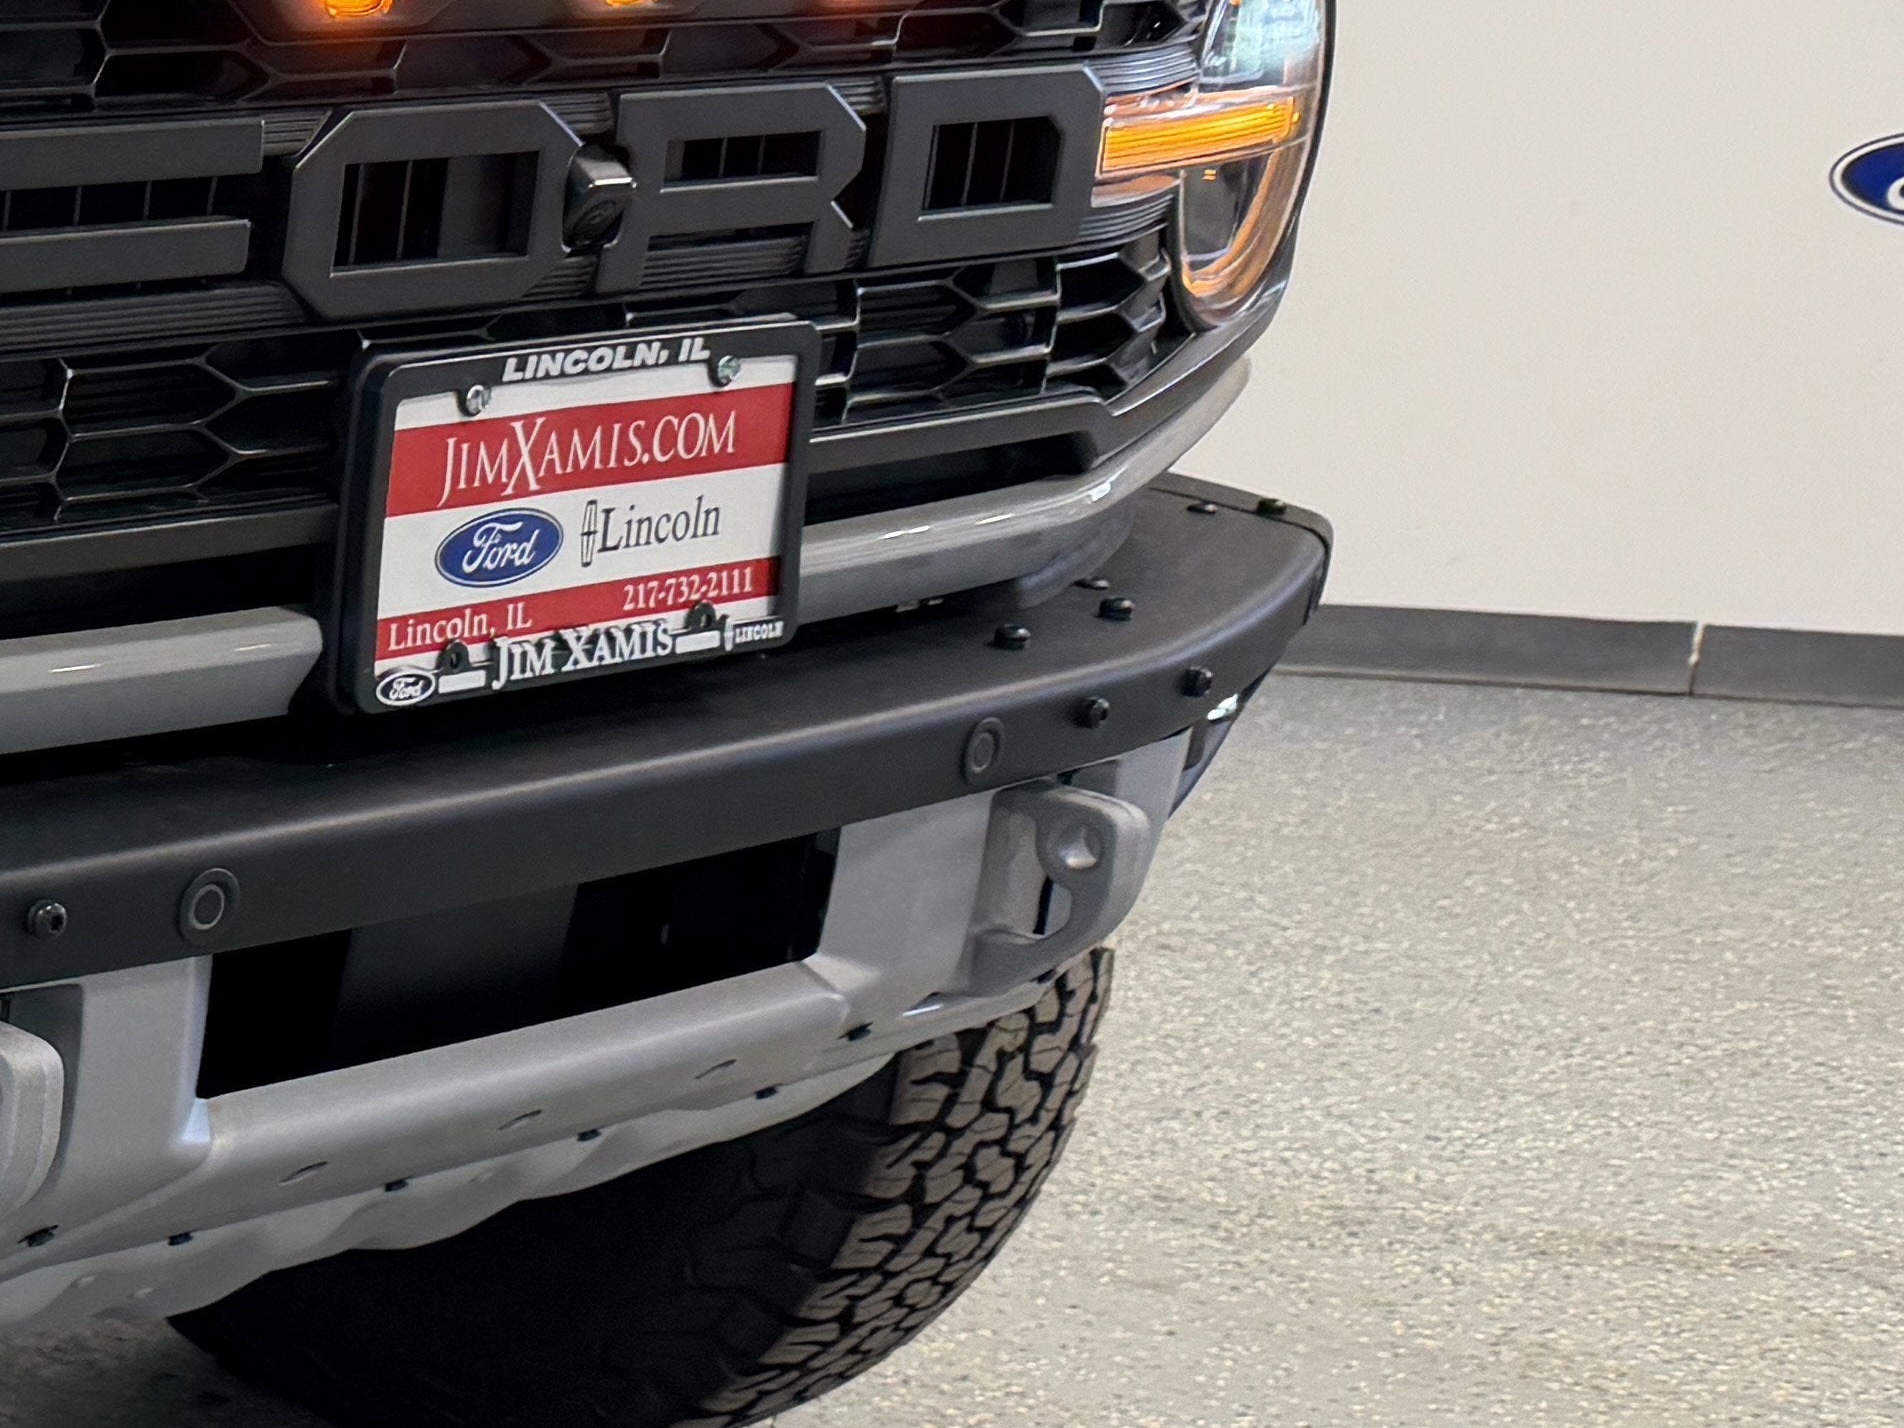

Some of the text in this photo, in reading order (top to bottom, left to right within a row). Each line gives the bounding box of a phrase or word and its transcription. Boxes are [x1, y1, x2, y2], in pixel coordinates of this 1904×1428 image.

[502, 337, 710, 382] LINCOLN, IL
[438, 410, 736, 507] JIMXAMIS.COM
[462, 520, 535, 572] Ford
[598, 495, 721, 553] Lincoln
[623, 566, 753, 611] 217-732-2111
[388, 602, 532, 651] Lincoln, IL
[735, 621, 784, 643] LINCOLN
[492, 622, 673, 690] JIM XAMIS
[389, 677, 422, 700] Ford
